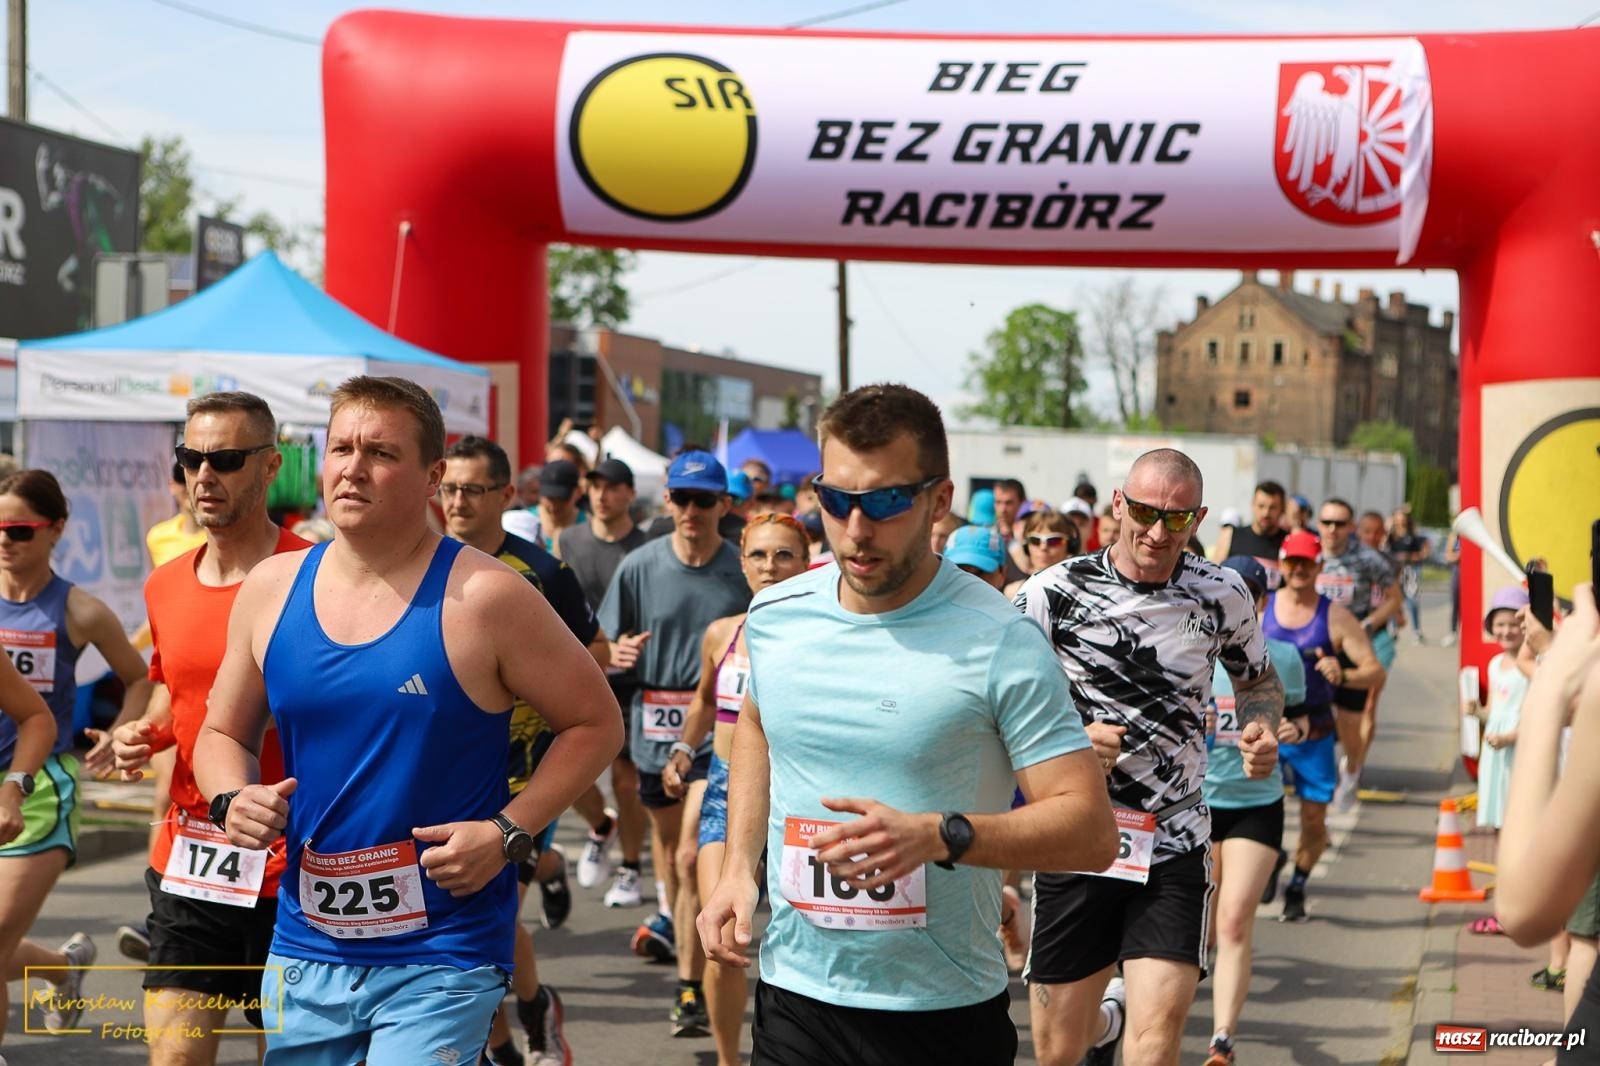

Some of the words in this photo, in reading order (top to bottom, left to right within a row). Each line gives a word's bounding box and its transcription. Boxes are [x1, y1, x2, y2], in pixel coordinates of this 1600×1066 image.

[664, 77, 753, 110] SIR
[928, 61, 1088, 94] BIEG
[808, 119, 941, 162] BEZ
[951, 121, 1201, 165] GRANIC
[840, 182, 1166, 231] RACIBÓRZ
[799, 823, 815, 833] XVI
[189, 843, 241, 883] 174
[316, 857, 337, 866] BIEG
[338, 855, 357, 865] BEZ
[358, 847, 399, 862] GRANIC
[314, 875, 400, 916] 225
